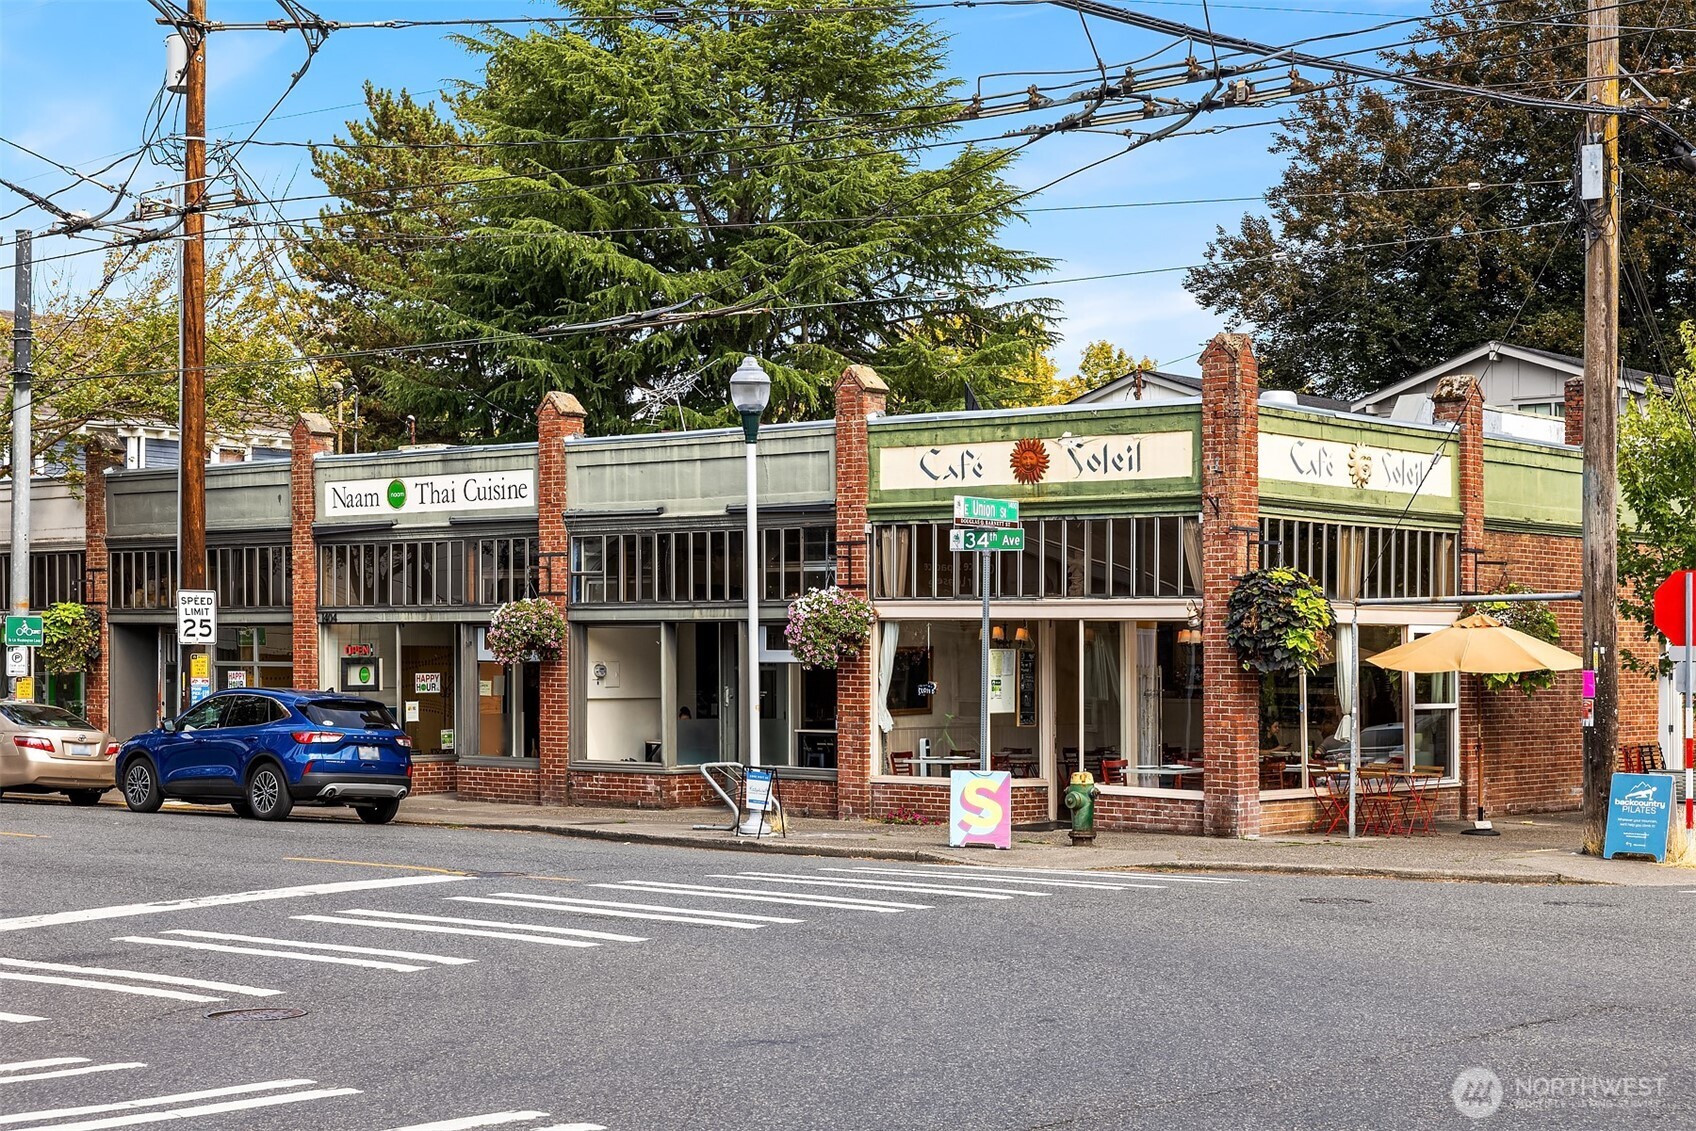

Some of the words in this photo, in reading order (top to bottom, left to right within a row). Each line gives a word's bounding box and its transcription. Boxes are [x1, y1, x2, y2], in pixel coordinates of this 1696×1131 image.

[919, 448, 984, 481] Café
[1067, 441, 1142, 479] Soleil
[1290, 440, 1334, 478] Café
[1381, 452, 1423, 488] Soleil
[332, 486, 381, 509] Naam
[415, 480, 456, 505] Thai
[463, 477, 528, 502] Cuisine
[964, 503, 969, 515] E
[973, 500, 996, 517] Union
[999, 507, 1007, 519] St
[965, 532, 998, 549] 34th
[1001, 535, 1021, 546] Ave
[181, 596, 213, 606] SPEED
[184, 608, 210, 616] LIMIT
[183, 619, 212, 637] 25
[344, 645, 370, 655] OPEN
[229, 672, 245, 680] HAPPY
[416, 674, 440, 683] HAPPY
[416, 683, 436, 692] HOUR
[959, 778, 1004, 832] S
[1614, 798, 1666, 810] backcountry
[1622, 806, 1657, 815] PILATES
